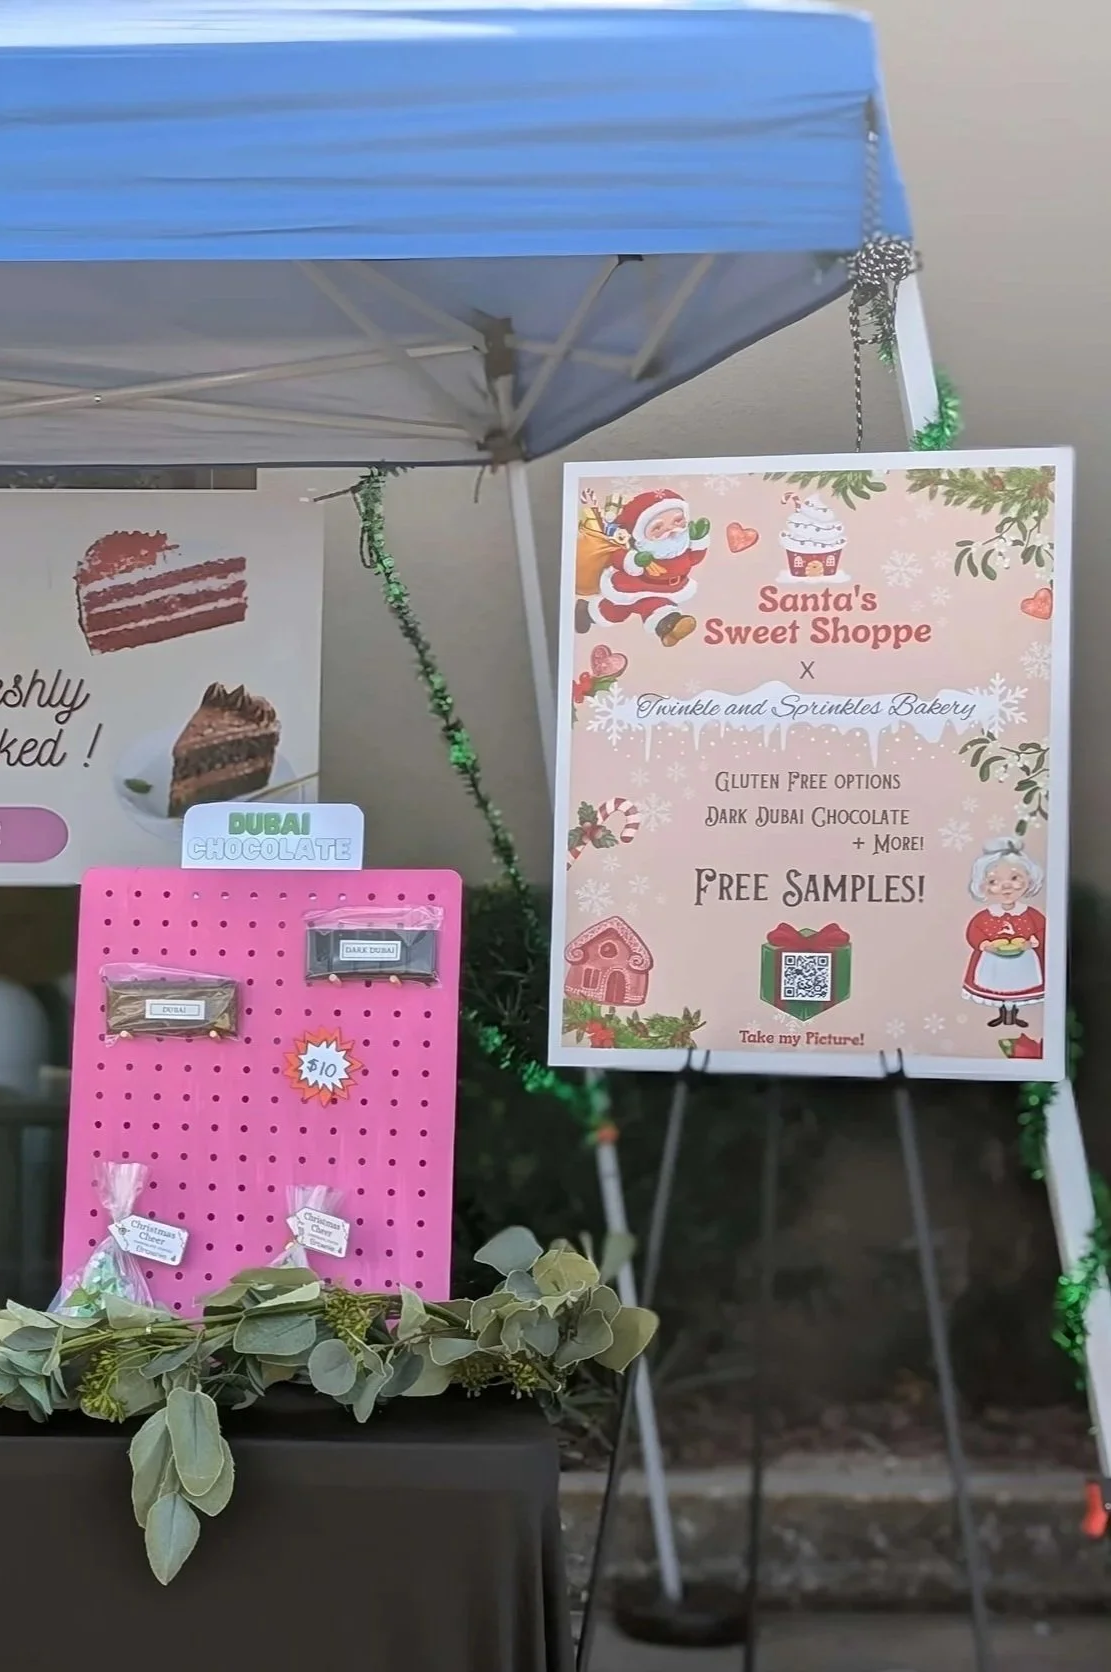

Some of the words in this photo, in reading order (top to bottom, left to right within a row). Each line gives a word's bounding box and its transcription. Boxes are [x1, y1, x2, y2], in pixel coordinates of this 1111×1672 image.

[758, 584, 877, 613] Santa's
[704, 617, 800, 645] Sweet
[809, 616, 932, 650] Shoppe
[799, 660, 815, 680] X
[636, 692, 721, 719] Twinkle
[723, 699, 766, 717] and
[770, 693, 884, 721] Sprinkles
[888, 691, 977, 720] Bakery
[715, 771, 780, 792] GLUTEN
[787, 771, 828, 792] FREE
[834, 774, 901, 790] OPTIONS
[228, 812, 311, 836] DUBAI
[704, 806, 748, 827] DARK
[755, 806, 804, 827] DUBAI
[811, 806, 910, 827] CHOCOLATE
[186, 837, 352, 861] CHOCOLATE
[872, 833, 924, 856] MORE!
[694, 868, 770, 906] FREE
[782, 868, 926, 908] SAMPLES!
[345, 946, 368, 954] DARK
[739, 1030, 774, 1044] Take
[779, 1034, 801, 1047] my
[805, 1031, 865, 1046] Picture!
[306, 1058, 337, 1078] $10
[130, 1219, 176, 1239] Christmas
[138, 1231, 166, 1246] Cheer
